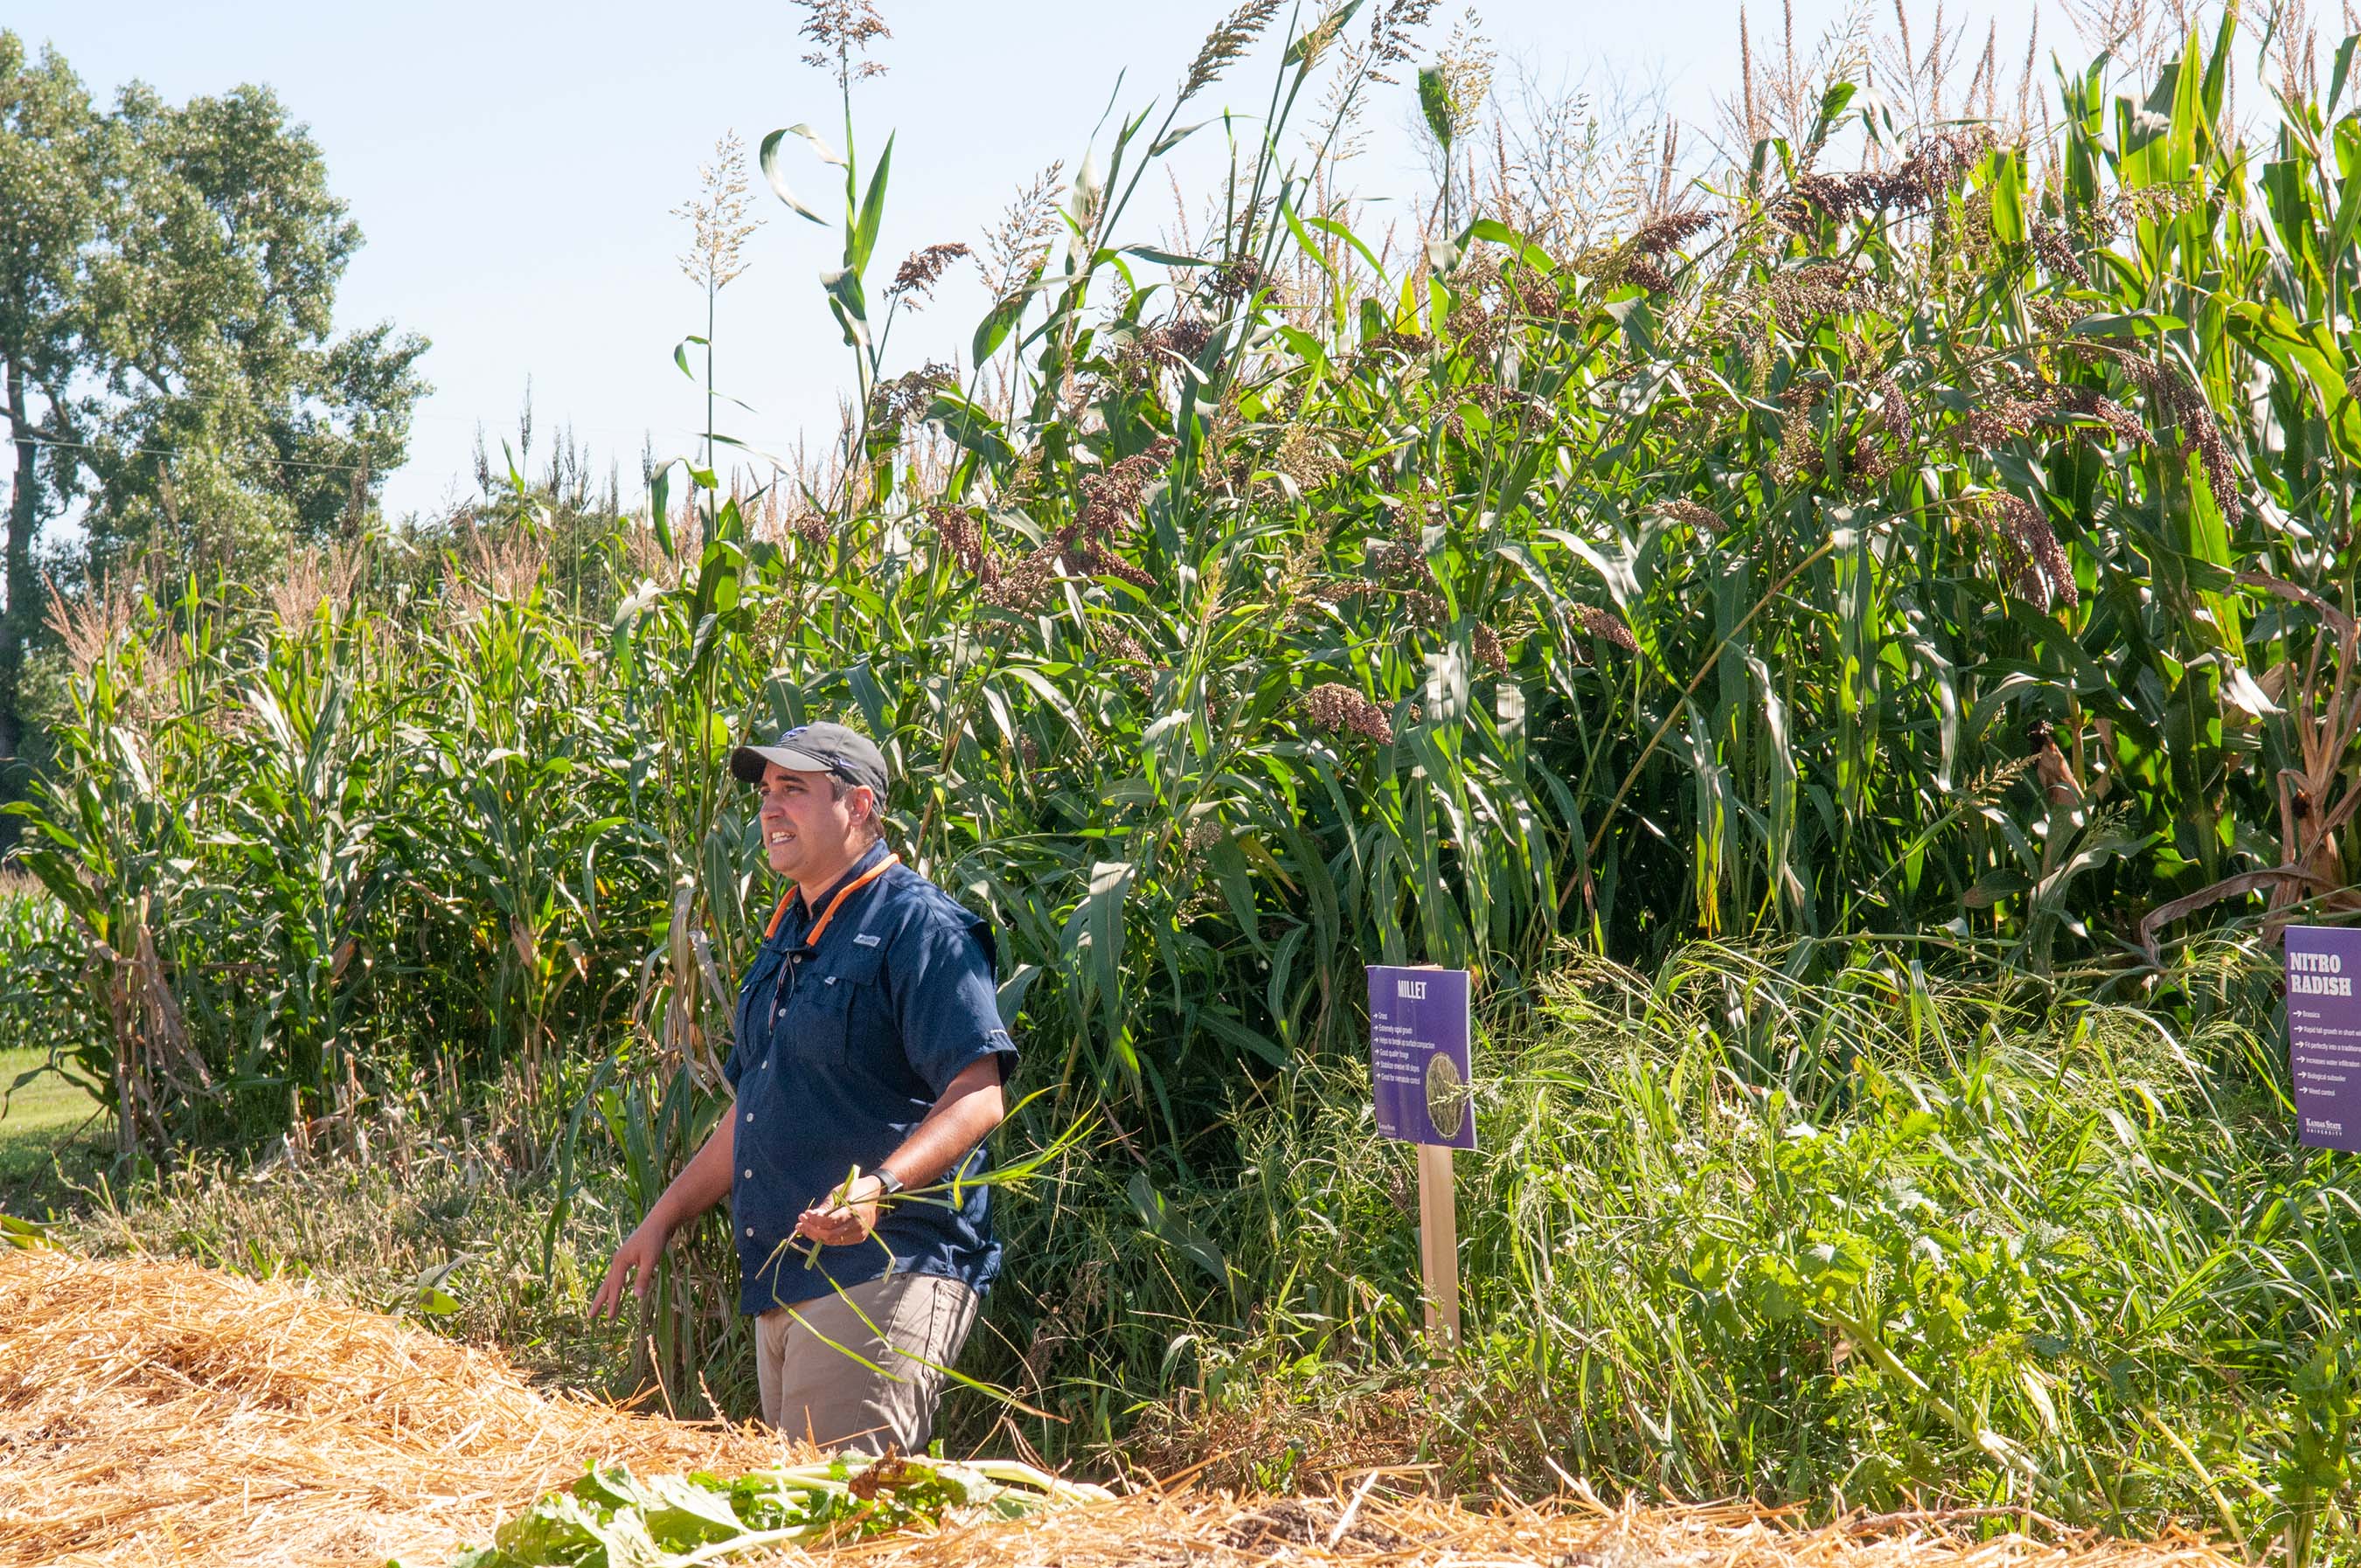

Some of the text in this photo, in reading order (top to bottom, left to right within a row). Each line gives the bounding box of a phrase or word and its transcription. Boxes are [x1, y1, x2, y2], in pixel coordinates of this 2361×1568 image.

[2290, 952, 2341, 974] NITRO
[1398, 980, 1427, 1000] MILLET
[2291, 975, 2351, 996] RADISH
[1378, 1024, 1393, 1035] Extremely
[2311, 1042, 2328, 1051] perfectly
[2306, 1057, 2325, 1065] Increases
[1381, 1072, 1390, 1081] Good
[2308, 1072, 2326, 1081] Biological
